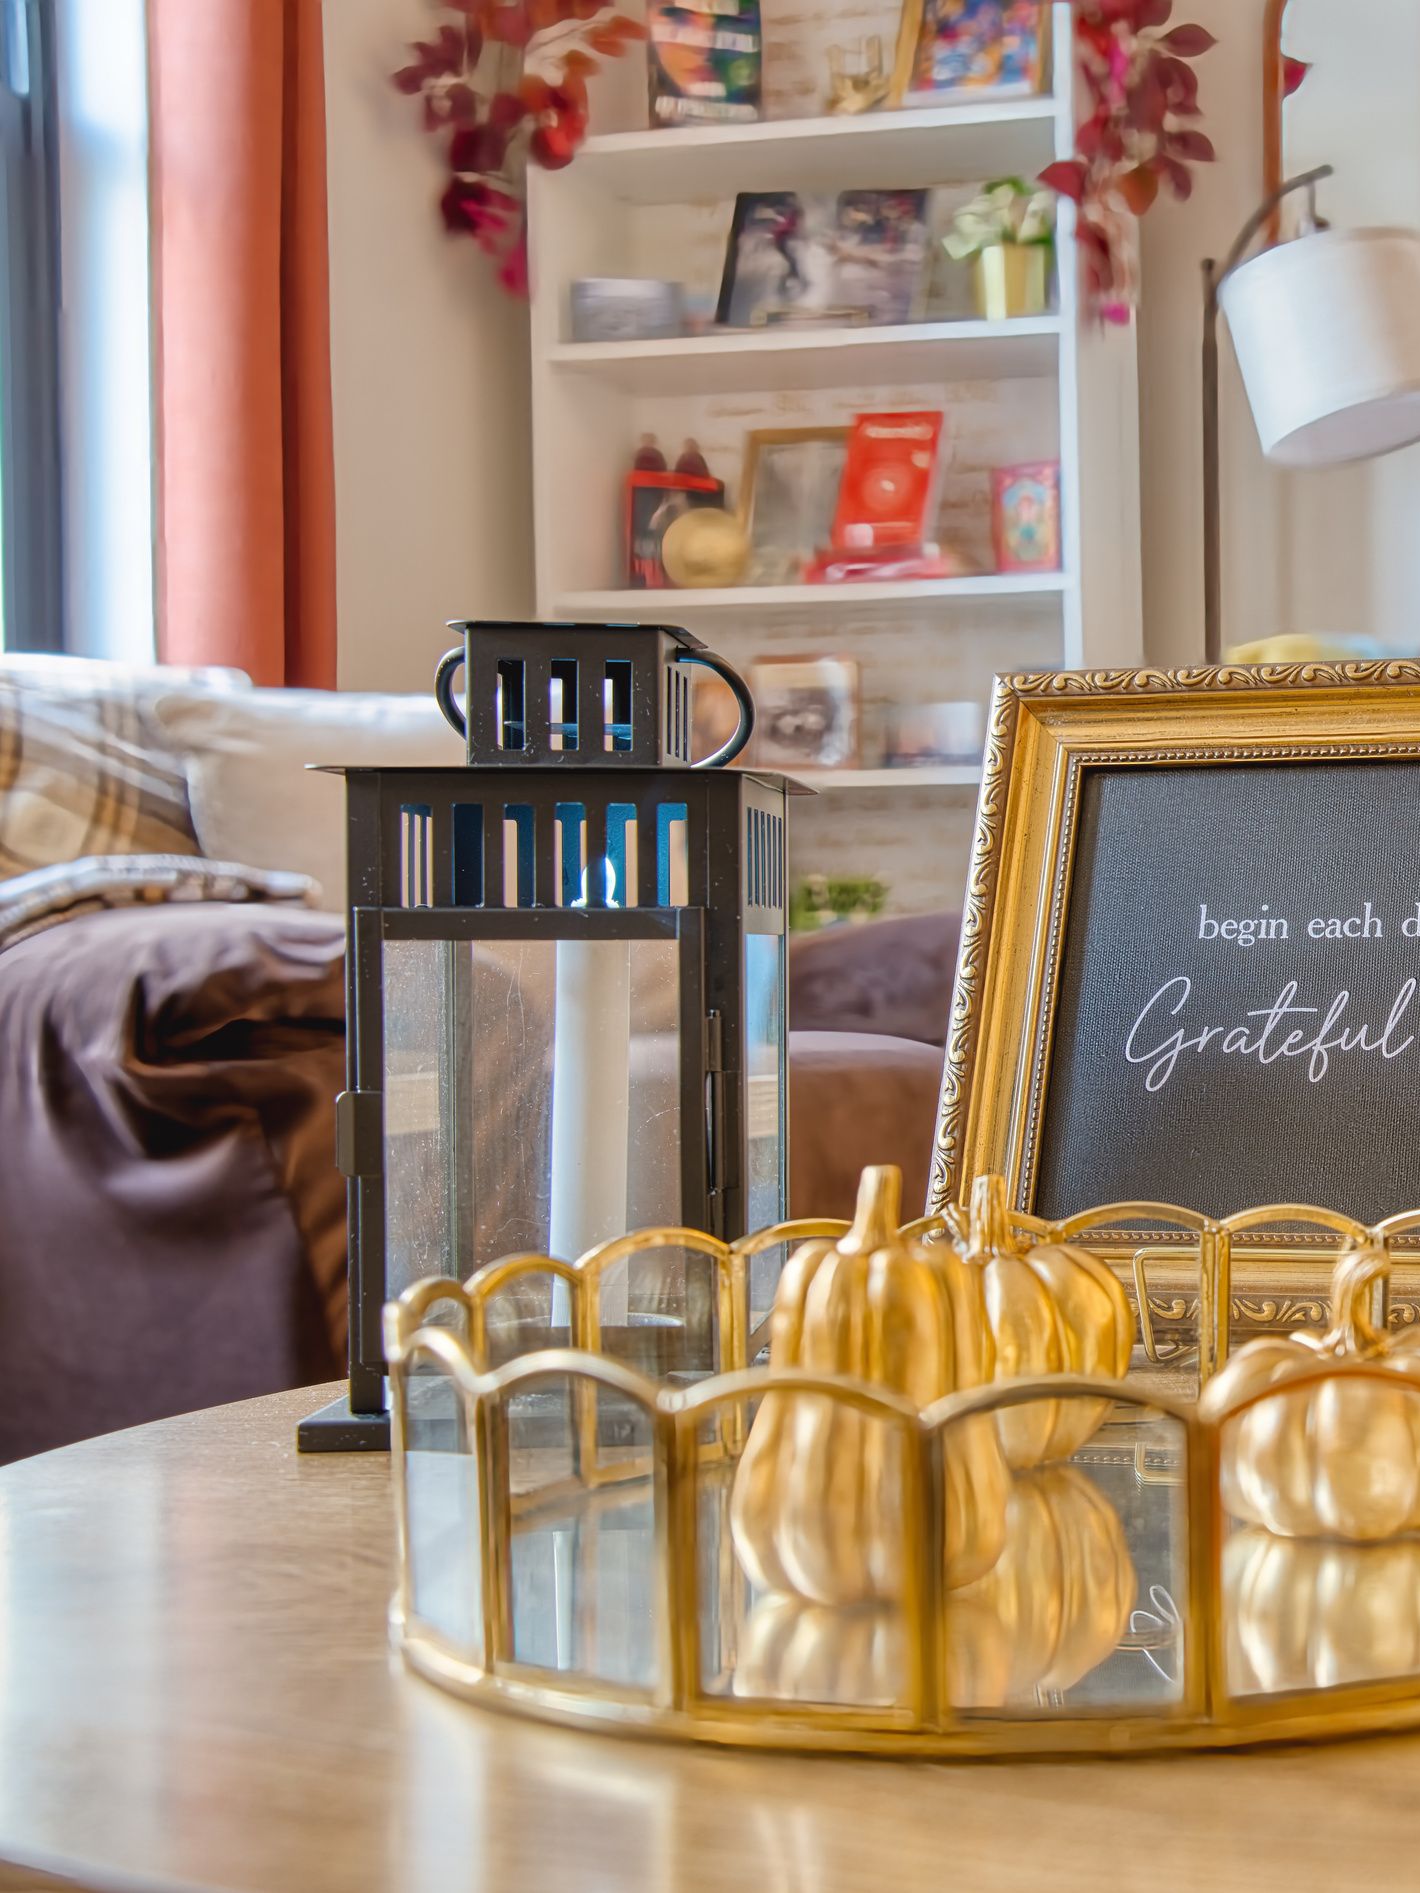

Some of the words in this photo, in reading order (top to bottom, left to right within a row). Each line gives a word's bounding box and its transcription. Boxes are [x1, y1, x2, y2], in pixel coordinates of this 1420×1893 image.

[1198, 903, 1289, 947] begin
[1307, 901, 1383, 939] each
[1124, 976, 1417, 1092] Grateful
